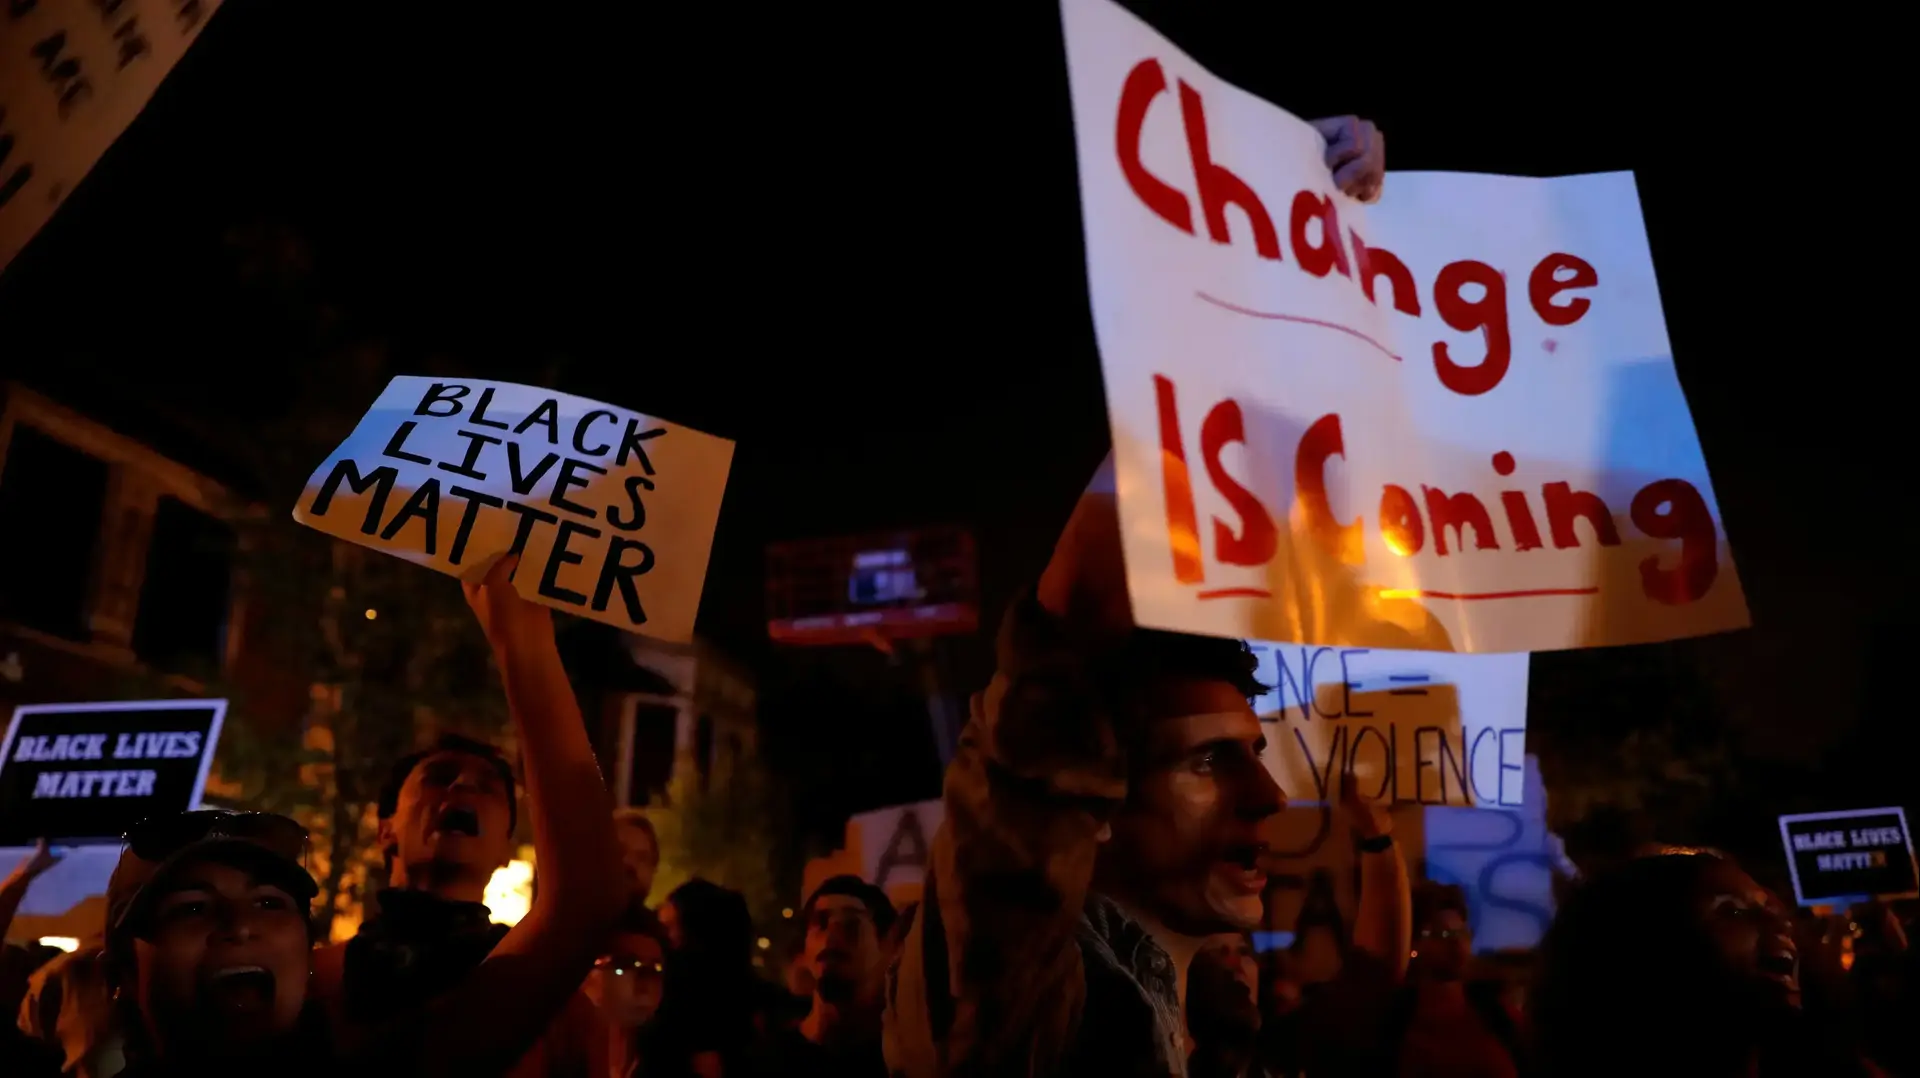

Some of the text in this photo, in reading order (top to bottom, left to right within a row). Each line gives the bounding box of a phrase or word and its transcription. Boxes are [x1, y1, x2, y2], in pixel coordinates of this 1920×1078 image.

[1116, 57, 1598, 395] Change
[414, 383, 667, 475] BLACK
[383, 421, 655, 532] LIVES
[1297, 413, 1718, 605] Coming
[310, 459, 656, 625] MATTER
[13, 730, 202, 763] BLACK LIVES
[31, 768, 158, 800] MATTER
[1293, 722, 1525, 807] VIOLENCE
[1793, 825, 1902, 852] BLACK LIVES
